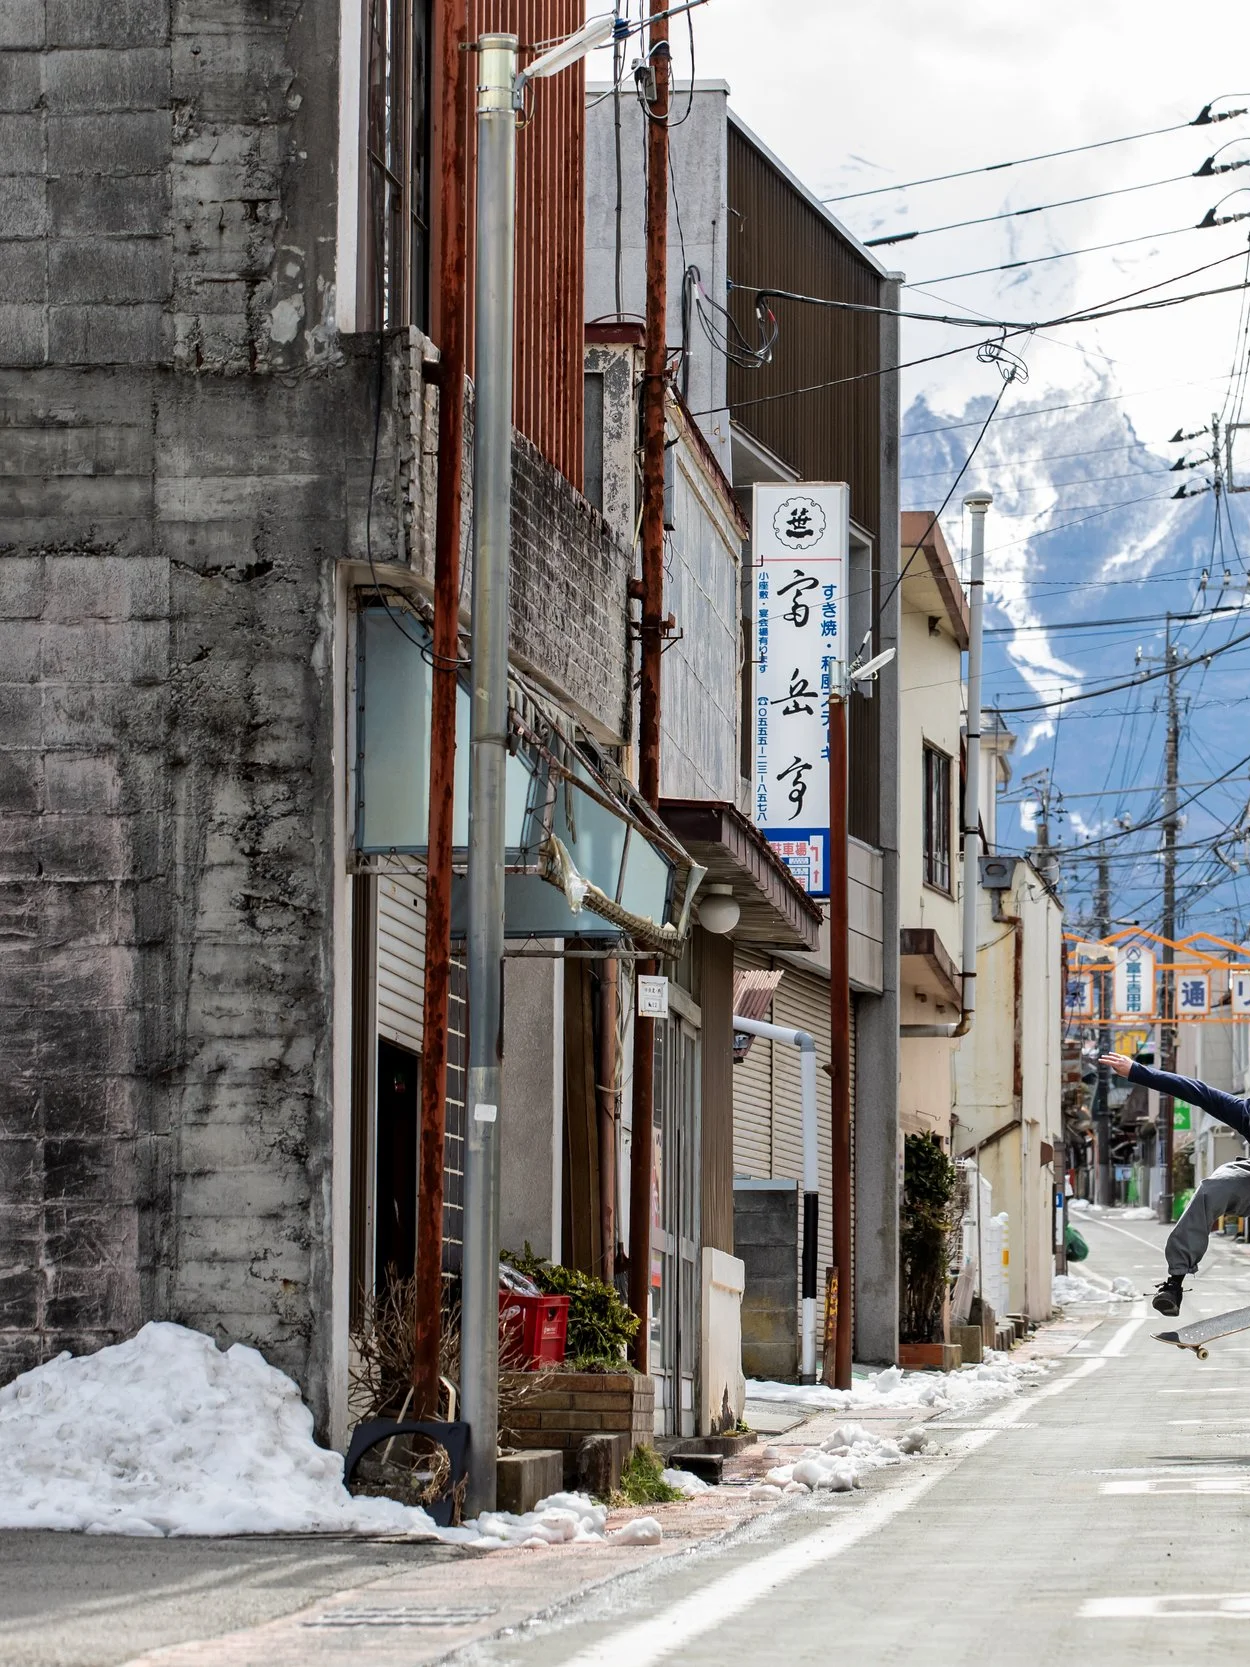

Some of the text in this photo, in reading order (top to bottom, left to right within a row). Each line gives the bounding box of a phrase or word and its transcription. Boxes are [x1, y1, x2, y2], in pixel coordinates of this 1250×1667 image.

[1126, 962, 1142, 1012] 富士吉田市
